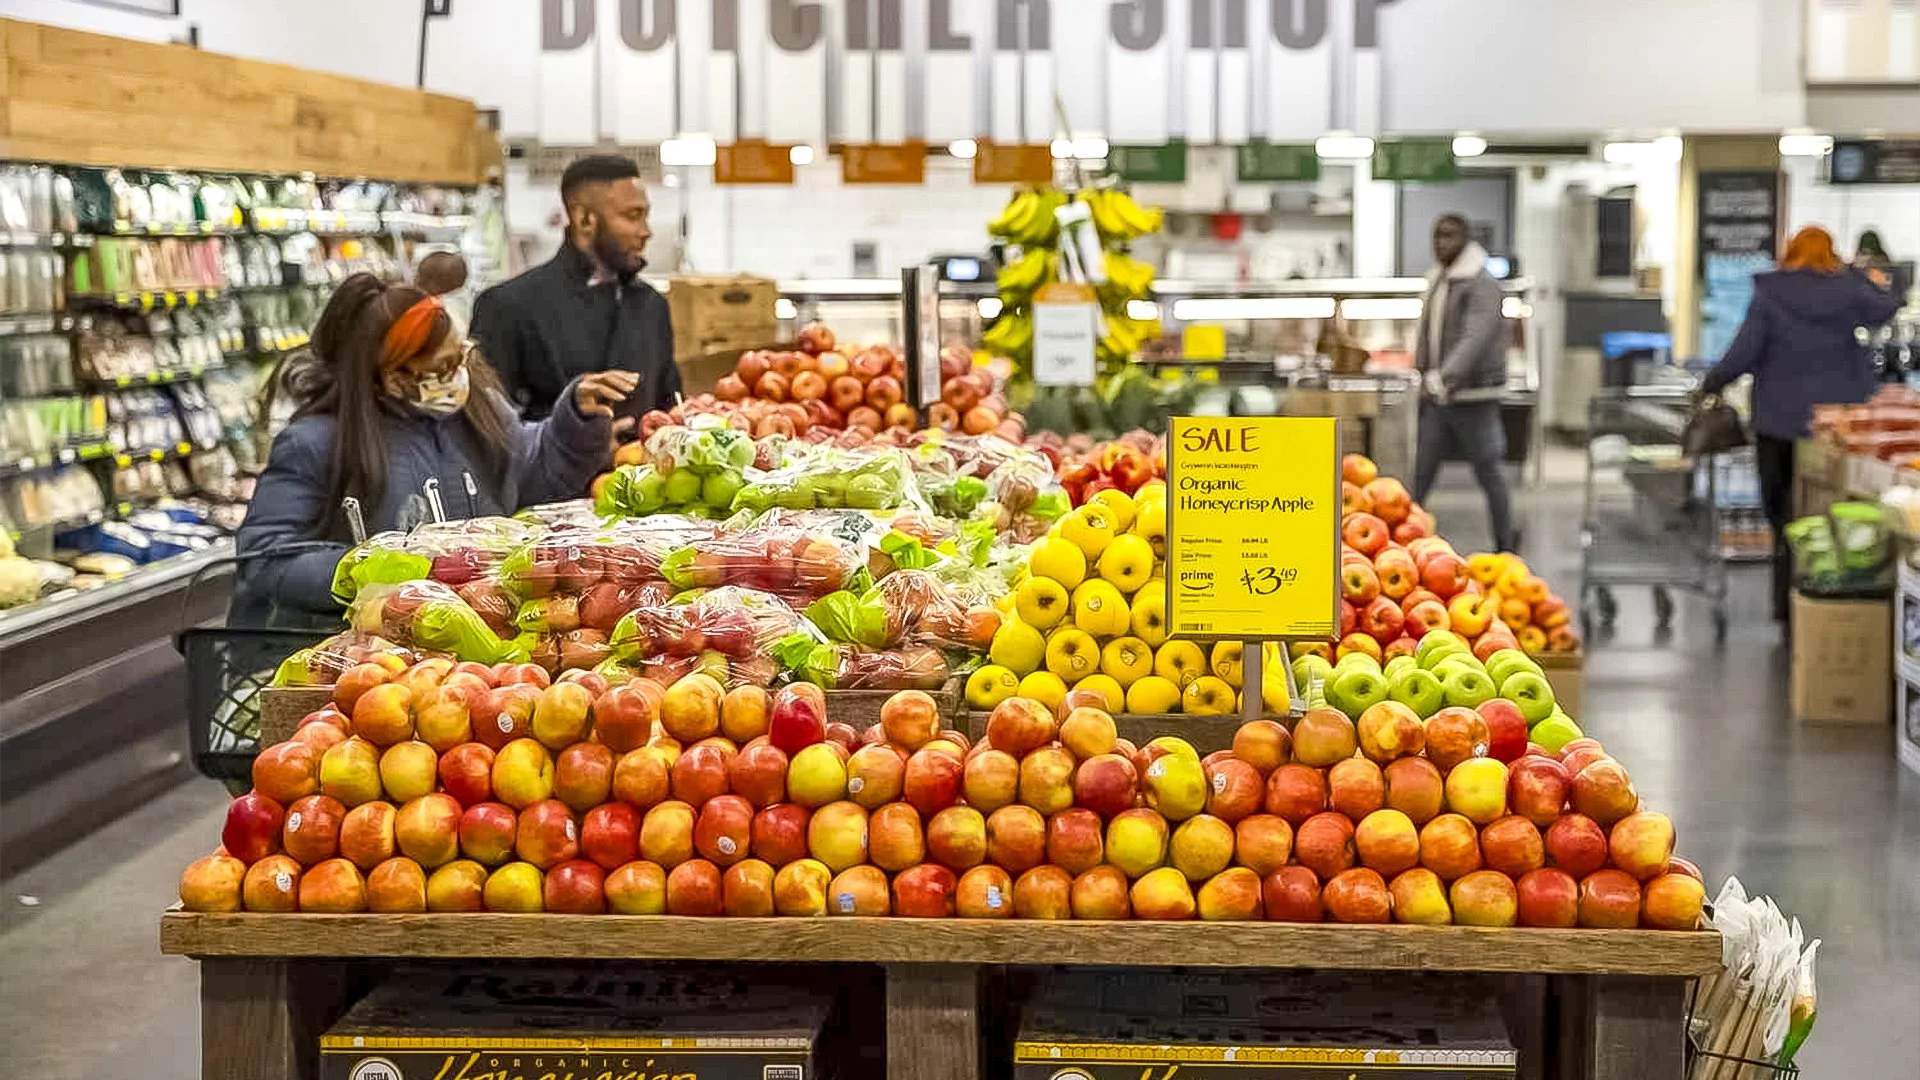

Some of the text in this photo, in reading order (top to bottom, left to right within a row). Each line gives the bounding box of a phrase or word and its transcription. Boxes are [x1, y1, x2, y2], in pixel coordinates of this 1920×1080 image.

[1181, 426, 1261, 453] SALE
[1180, 476, 1247, 495] Organic
[1180, 496, 1315, 514] Honeycrisp Apple
[1180, 570, 1214, 582] prime
[490, 1058, 631, 1068] ORGANIC
